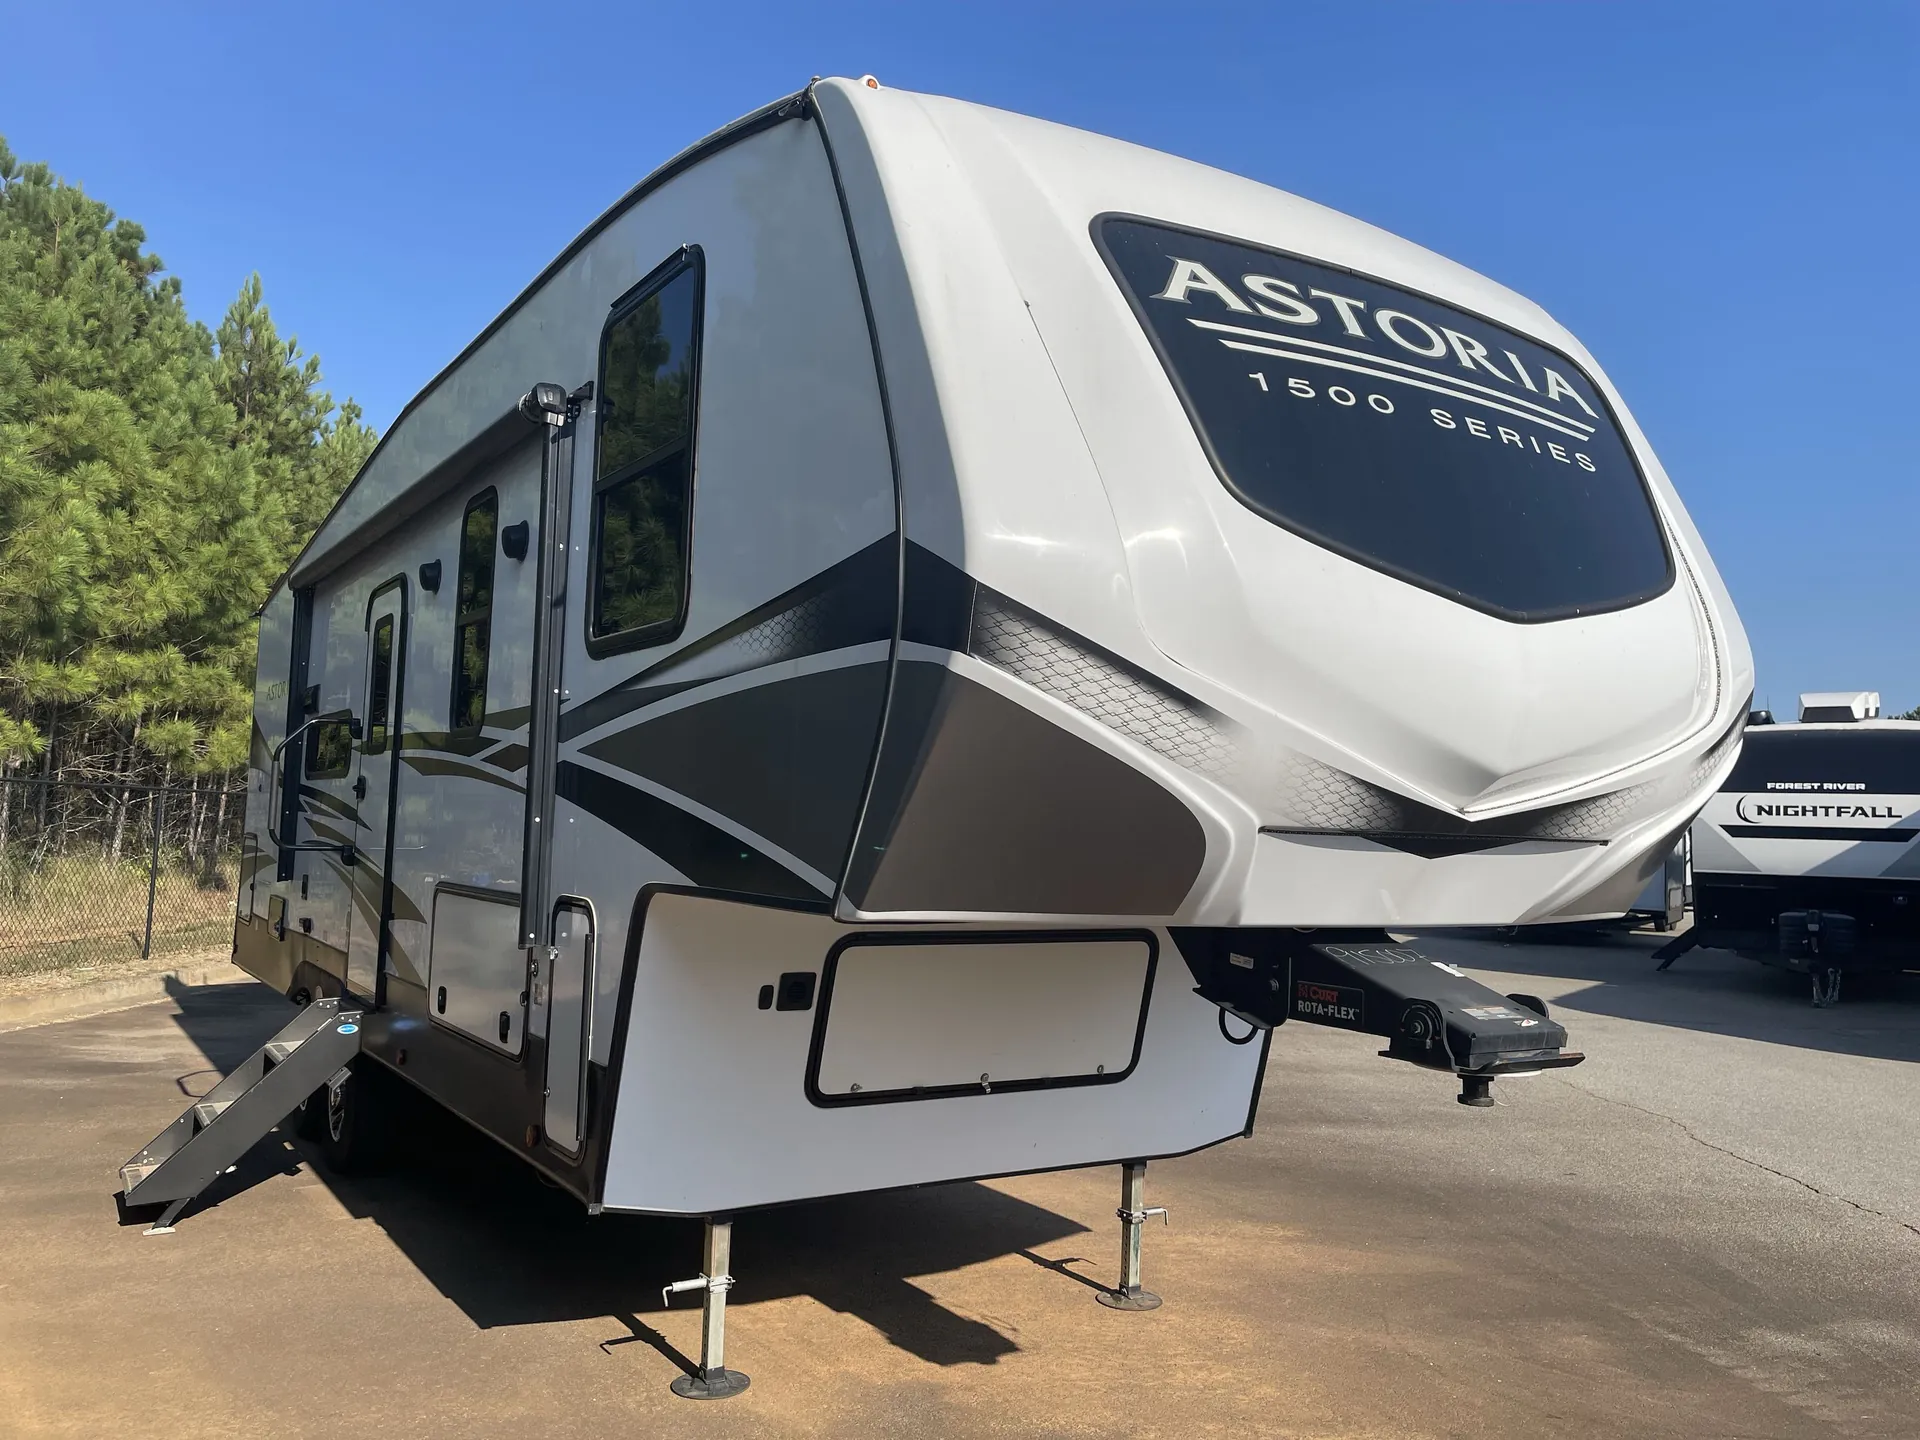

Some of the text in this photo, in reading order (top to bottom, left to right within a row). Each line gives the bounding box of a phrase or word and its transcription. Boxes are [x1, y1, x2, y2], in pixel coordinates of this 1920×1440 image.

[1151, 255, 1602, 420] ASTORIA
[1248, 372, 1596, 473] 1500 SERIES
[1754, 804, 1903, 819] NIGHTFALL
[1766, 782, 1866, 791] FOREST RIVER
